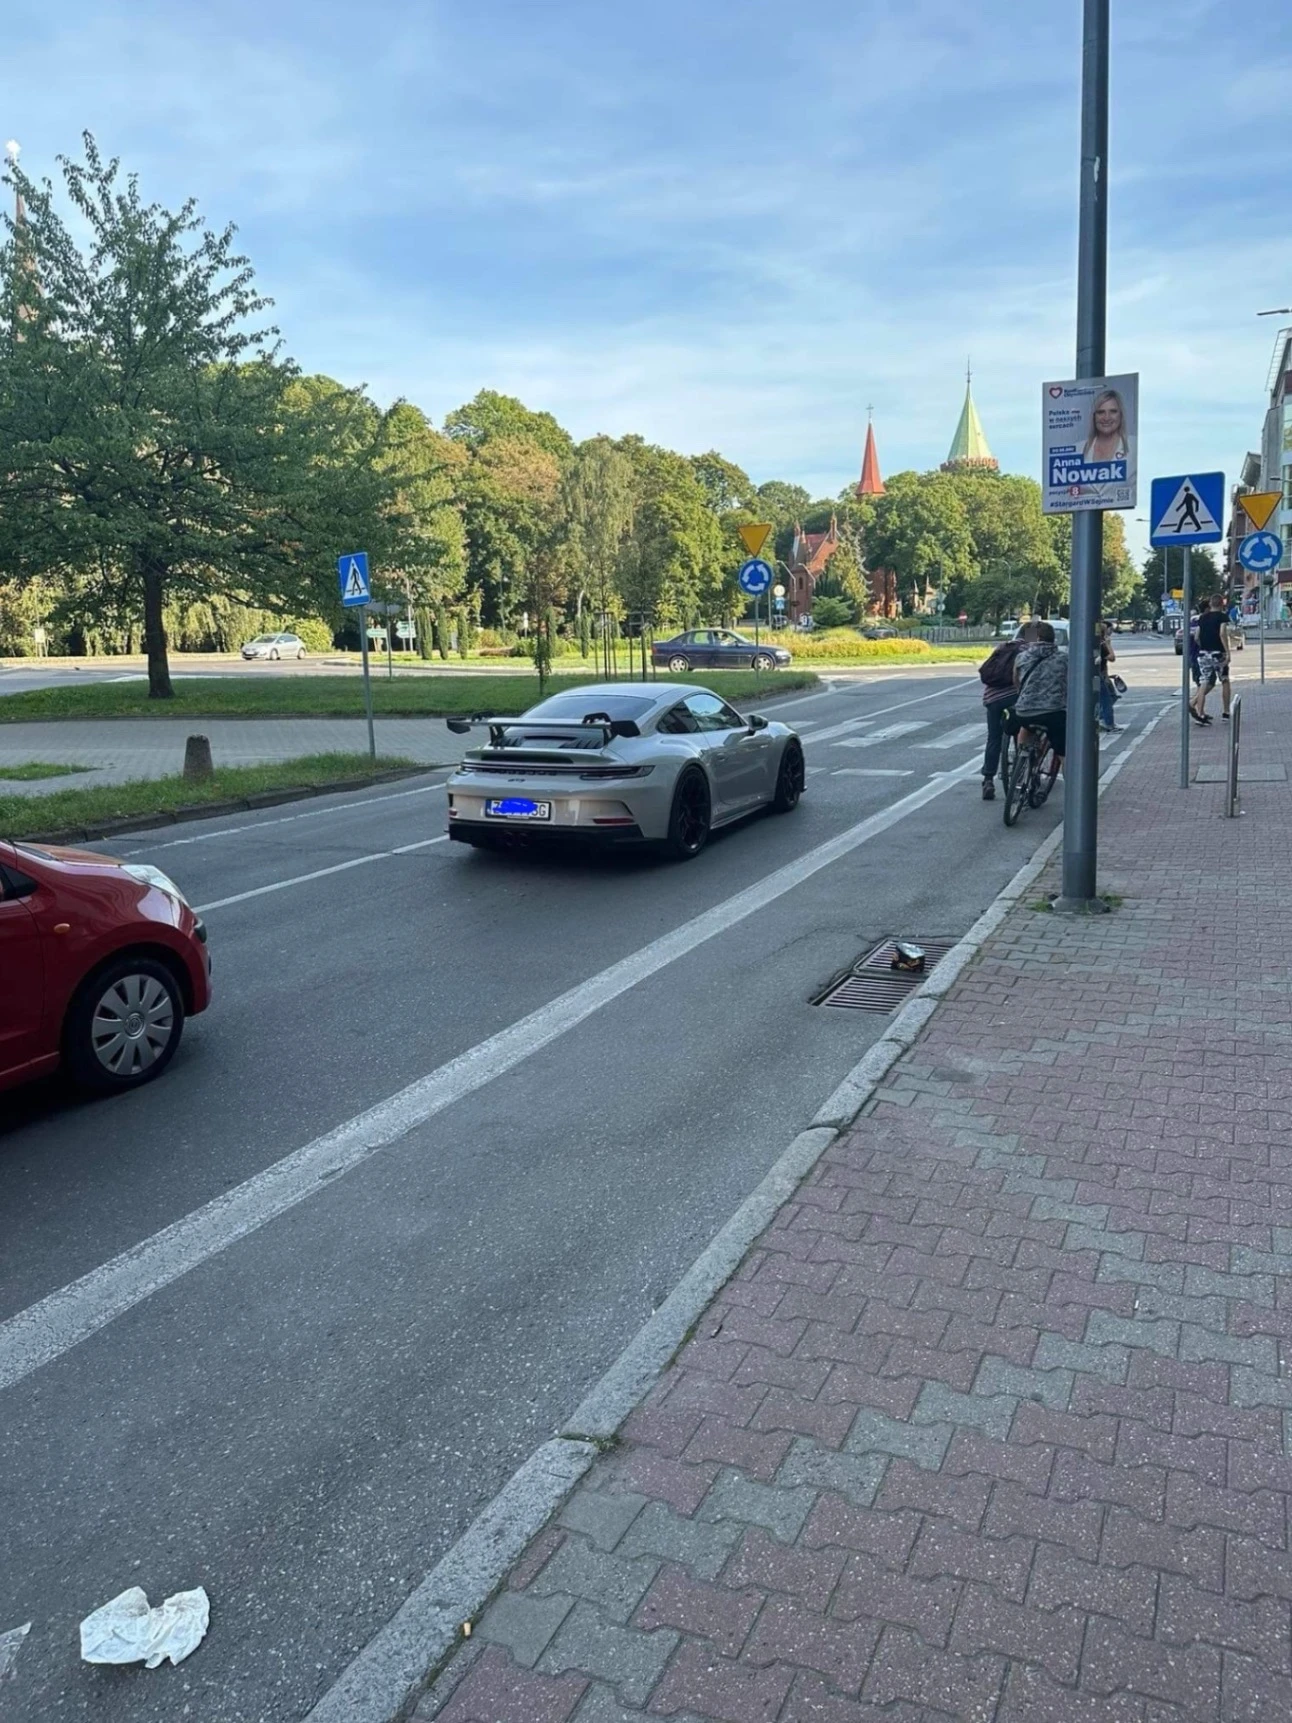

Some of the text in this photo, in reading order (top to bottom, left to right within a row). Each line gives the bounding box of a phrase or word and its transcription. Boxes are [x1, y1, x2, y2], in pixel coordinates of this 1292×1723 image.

[1053, 458, 1081, 467] Anna
[1052, 463, 1124, 484] Nowak
[1072, 486, 1079, 495] 8
